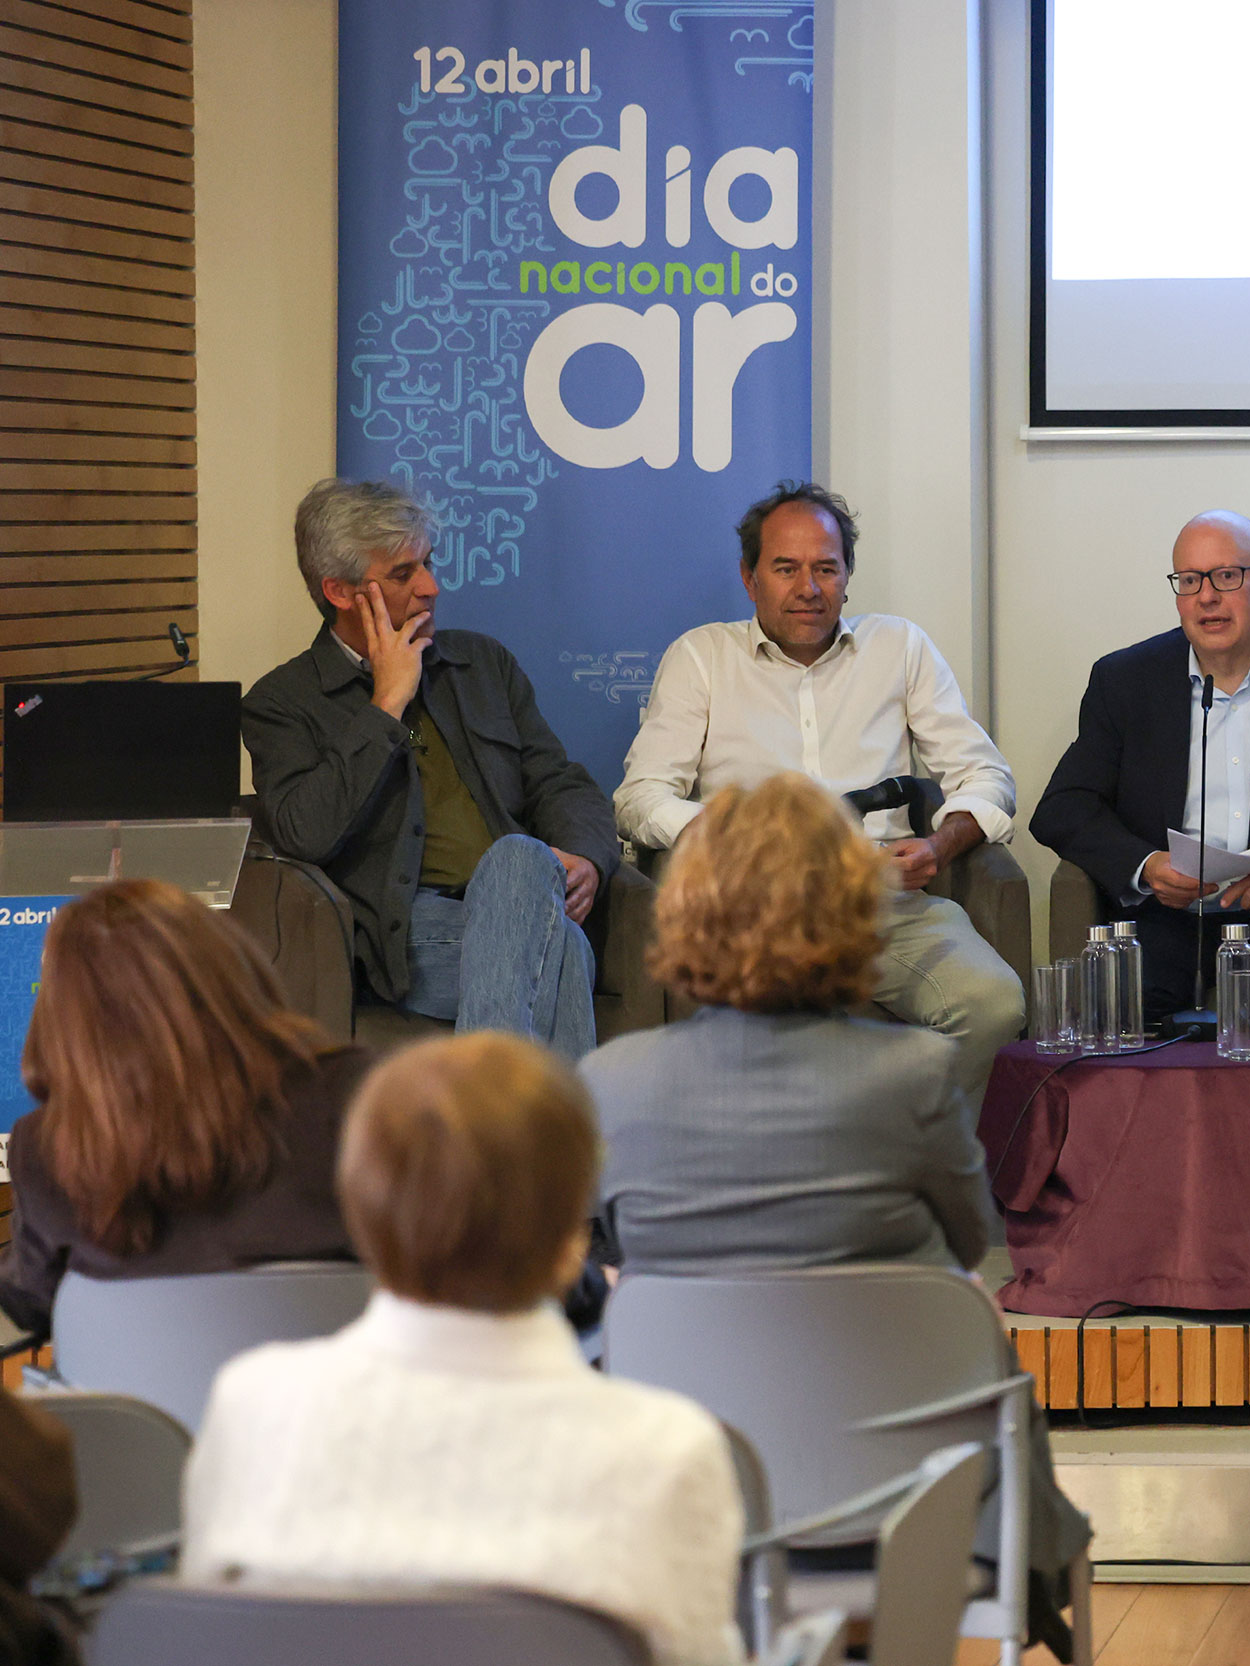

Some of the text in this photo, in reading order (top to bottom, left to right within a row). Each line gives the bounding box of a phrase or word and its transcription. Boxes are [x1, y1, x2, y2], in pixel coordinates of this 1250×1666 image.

[414, 46, 591, 95] 12 abril
[548, 104, 799, 250] dia
[519, 251, 799, 298] nacional do
[523, 301, 798, 473] ar
